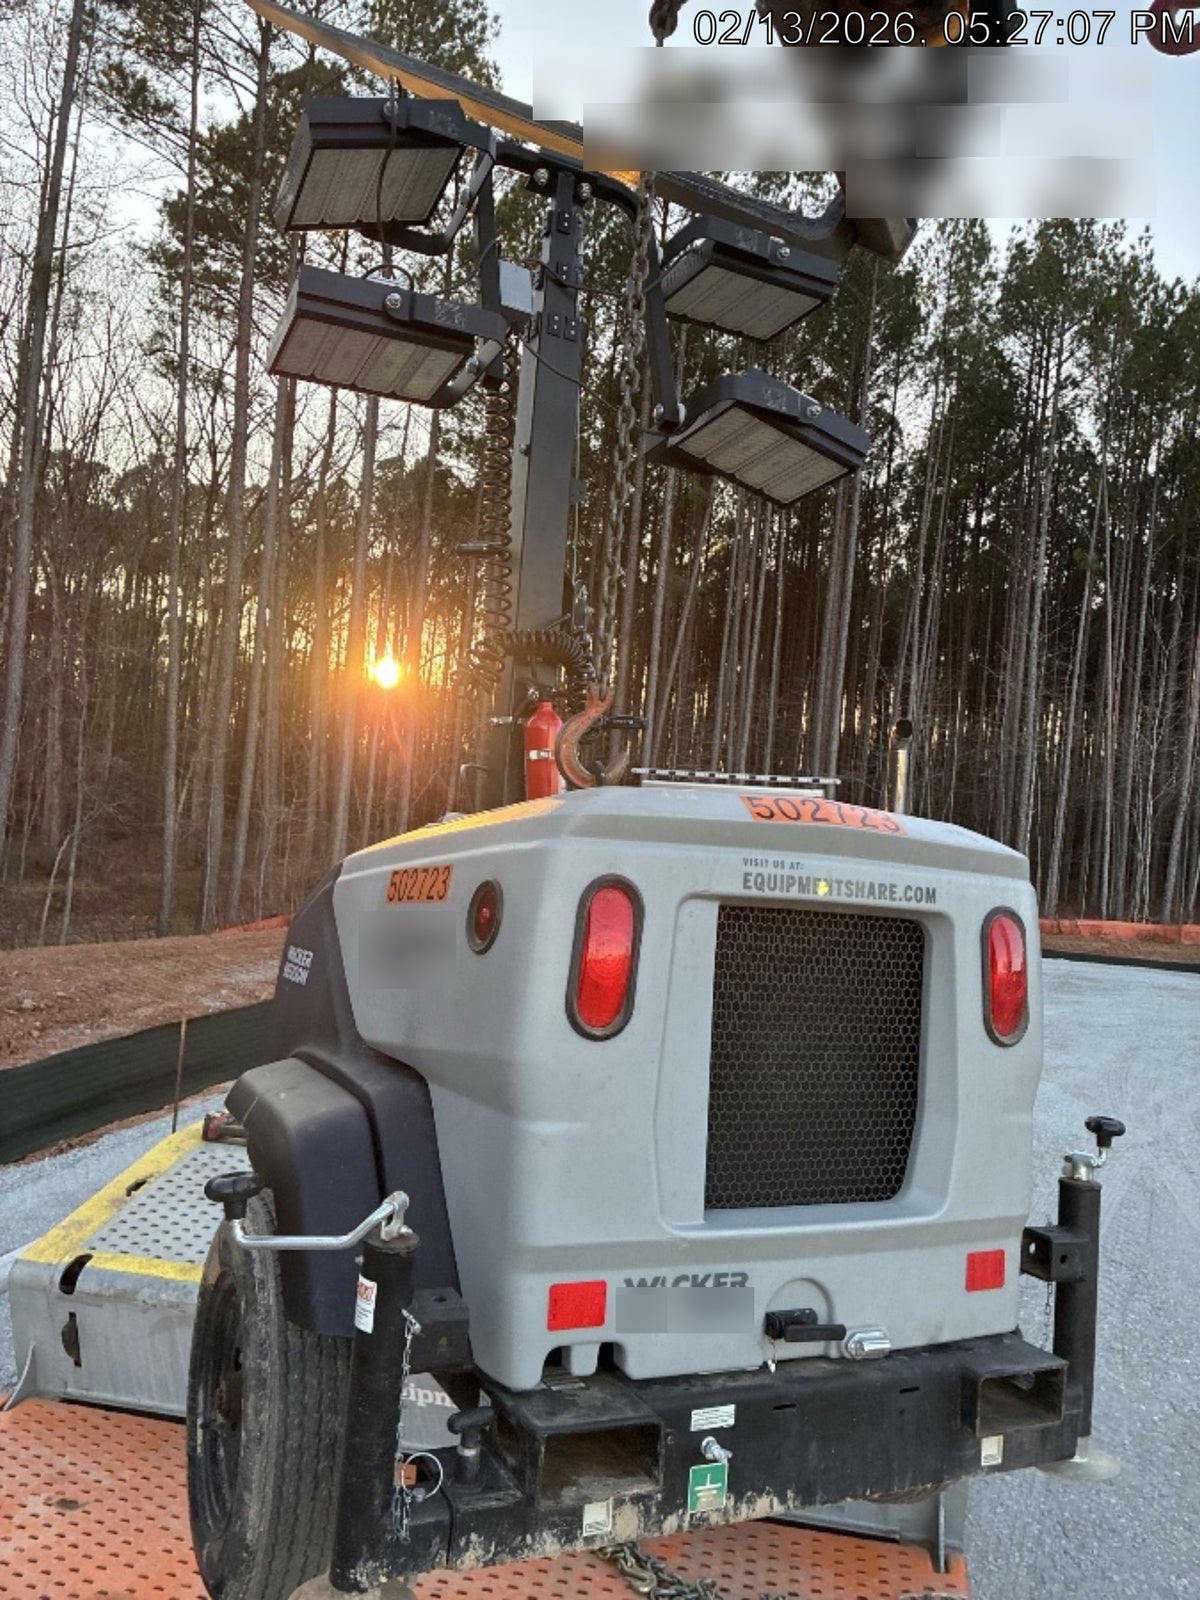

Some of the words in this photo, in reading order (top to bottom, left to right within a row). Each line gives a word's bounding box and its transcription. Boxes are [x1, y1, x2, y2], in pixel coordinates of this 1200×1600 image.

[746, 796, 901, 833] 502723
[742, 857, 769, 868] VISIT
[773, 859, 785, 870] US
[789, 861, 804, 871] AT:
[387, 865, 450, 902] 502723
